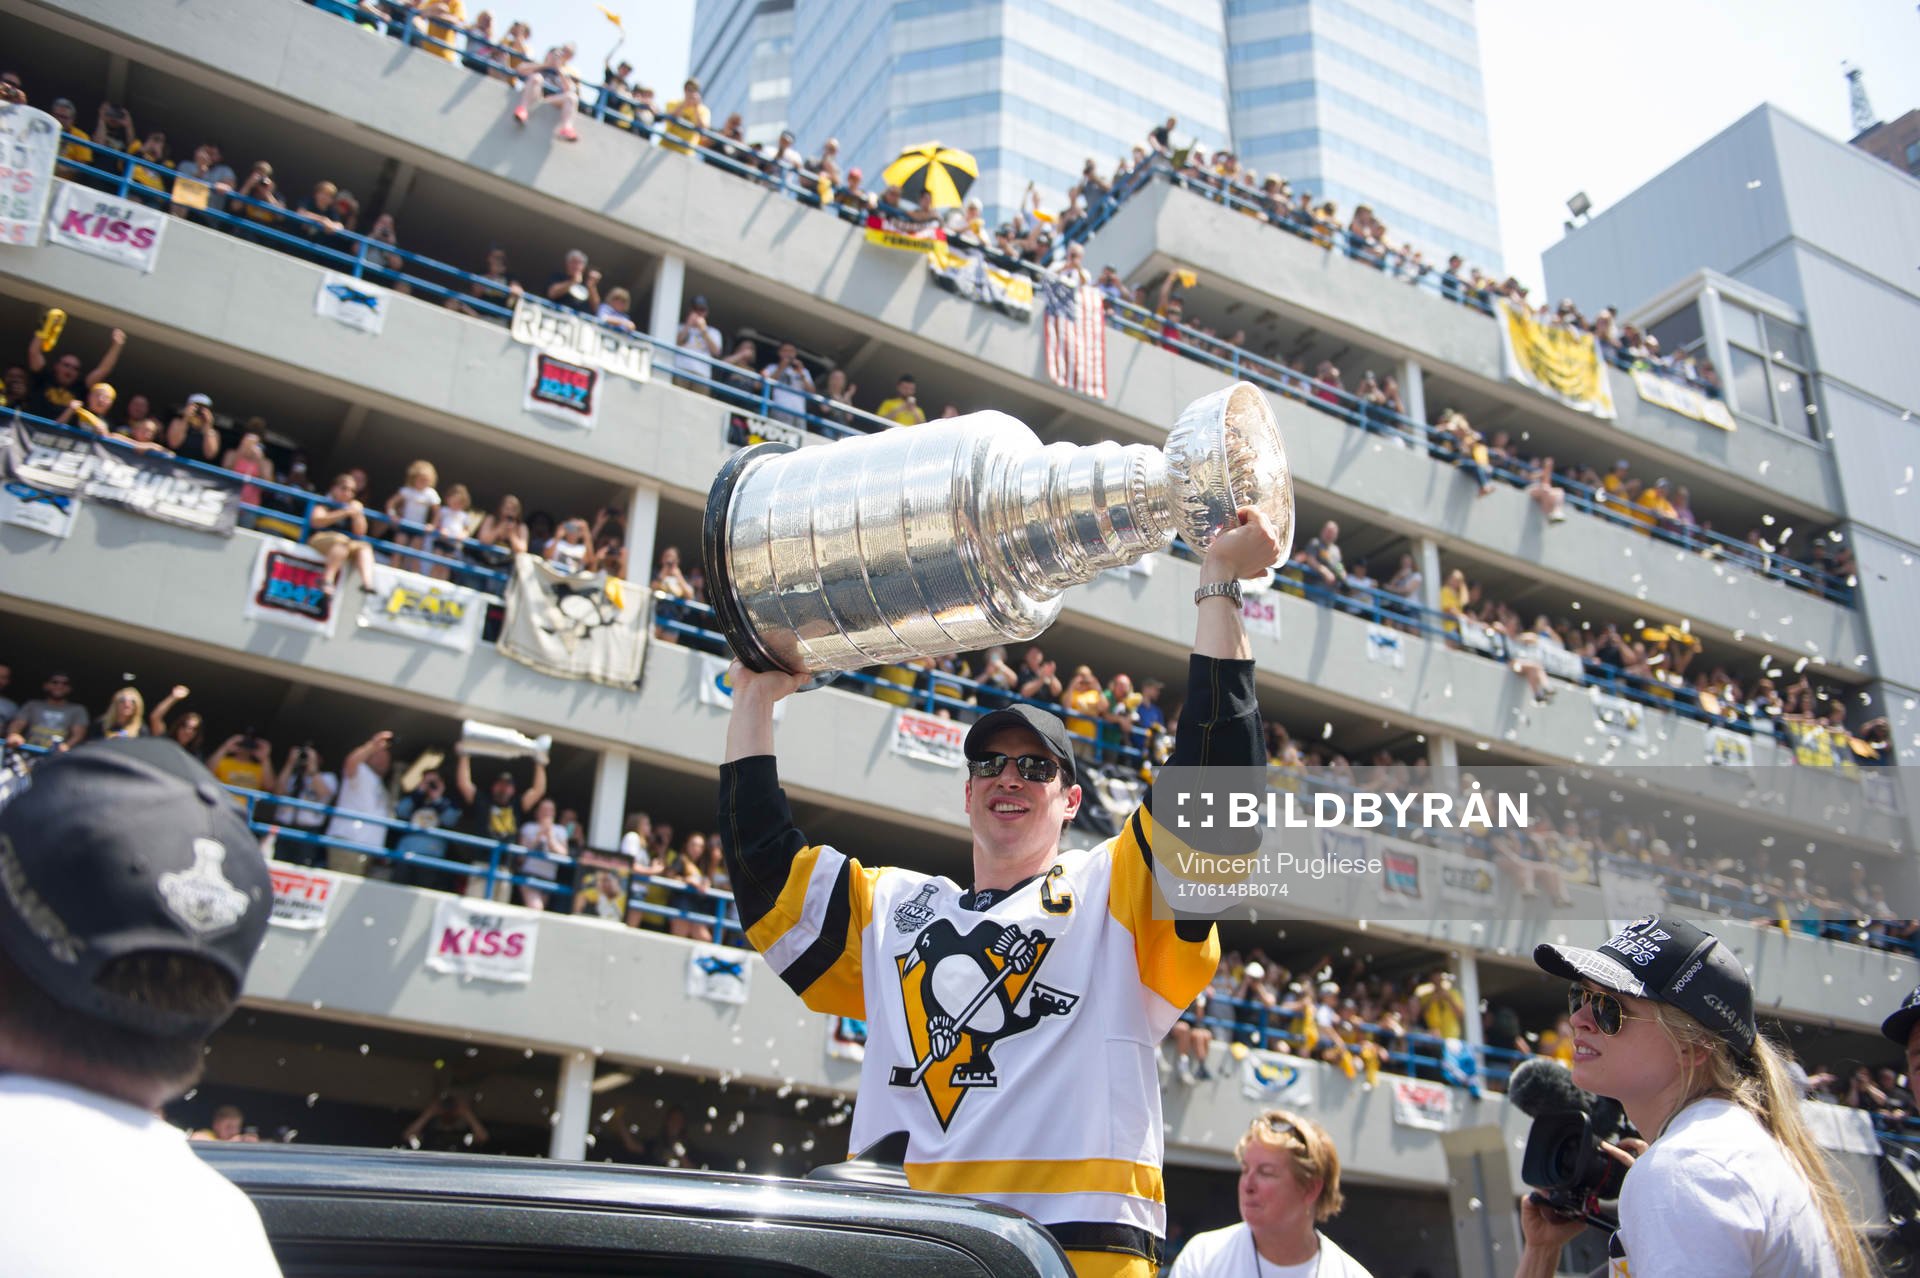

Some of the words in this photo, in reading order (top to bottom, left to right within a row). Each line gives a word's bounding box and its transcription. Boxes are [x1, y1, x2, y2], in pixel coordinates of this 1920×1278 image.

[61, 209, 157, 249] KISS
[1243, 599, 1275, 622] ISS
[1041, 865, 1074, 916] C
[438, 927, 527, 958] KISS
[1636, 937, 1661, 953] CUP
[1672, 959, 1703, 994] Reebok
